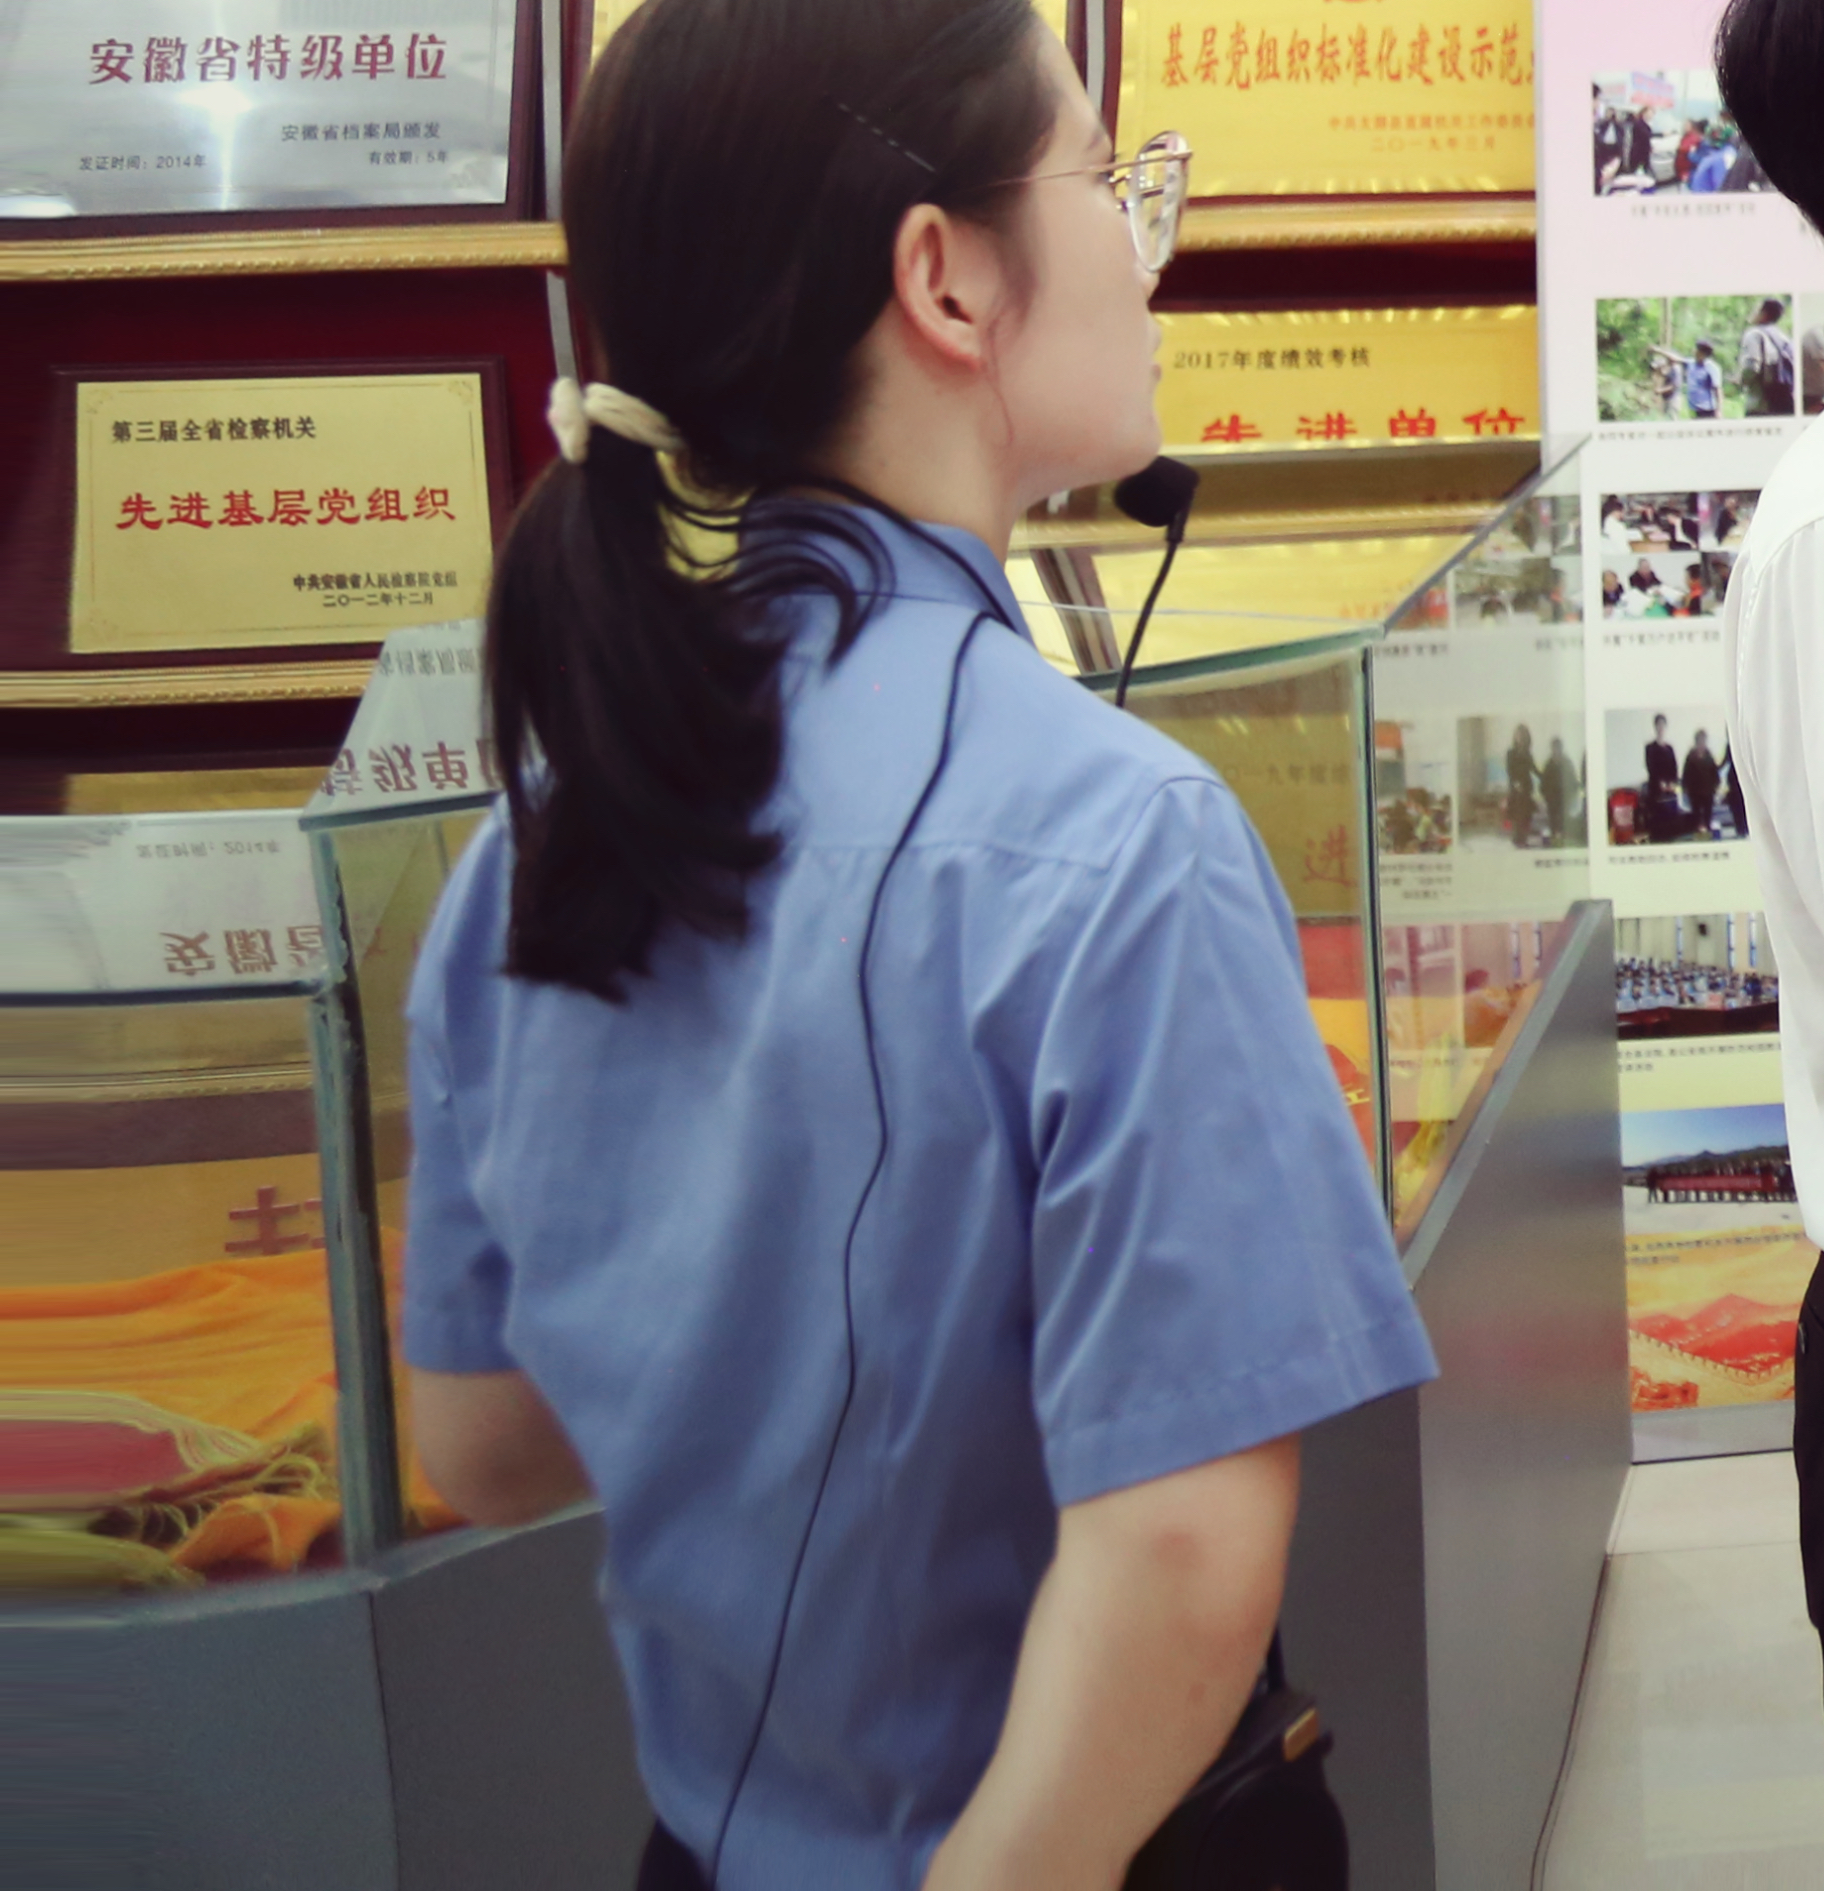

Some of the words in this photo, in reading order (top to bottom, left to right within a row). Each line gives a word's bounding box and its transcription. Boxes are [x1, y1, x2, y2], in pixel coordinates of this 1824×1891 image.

[87, 34, 449, 85] 安徽省特级单位
[281, 122, 442, 141] 安徽省档案局颁发
[1174, 347, 1371, 370] 2017年度绩效考核
[111, 417, 317, 444] 第三届全省检察机关
[115, 486, 458, 531] 先进基层党组织
